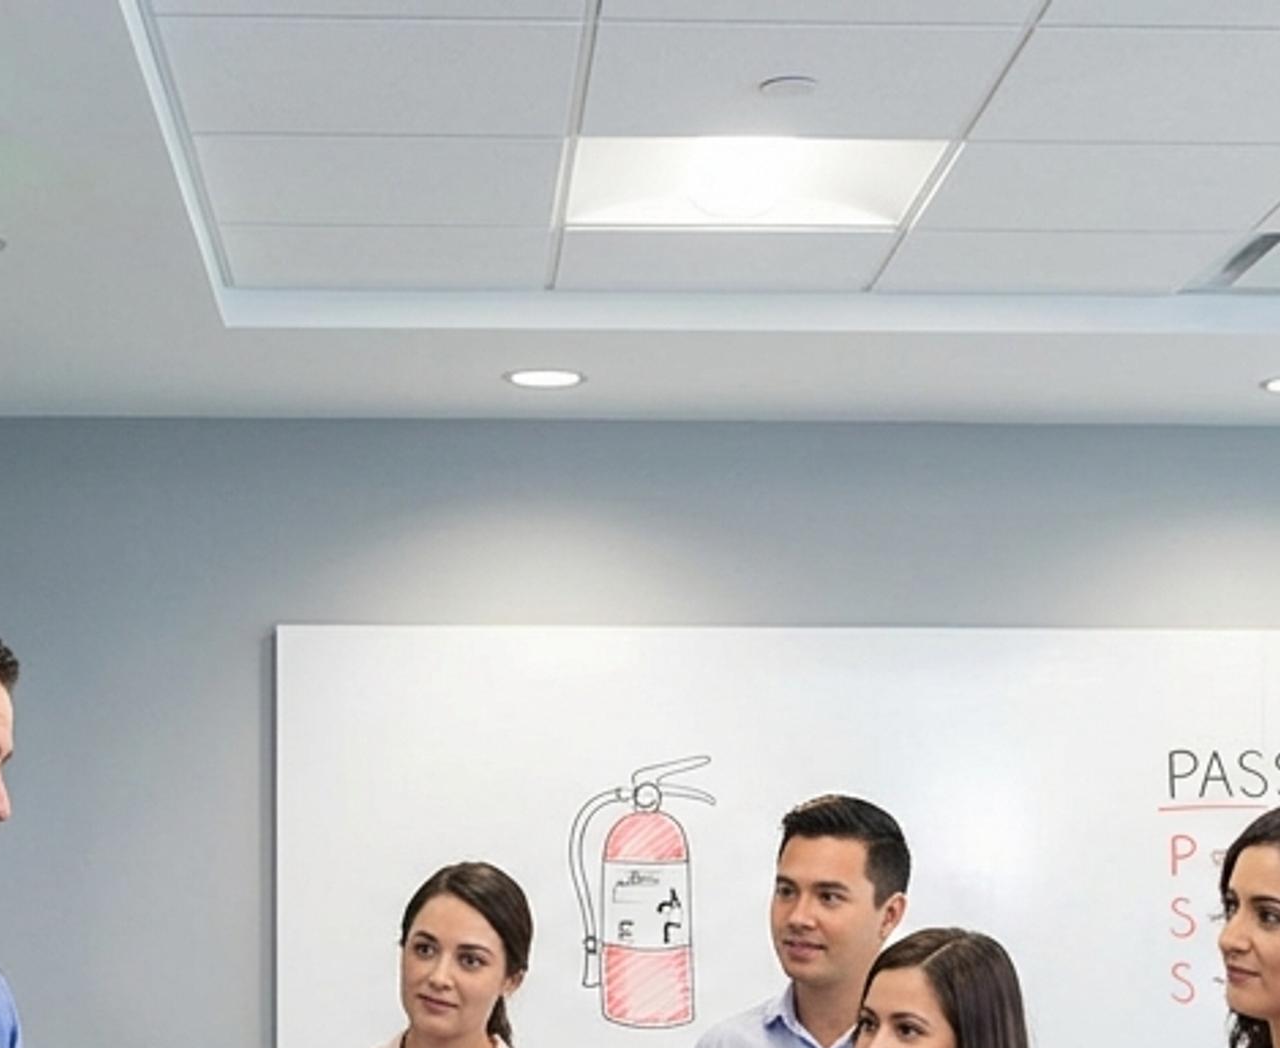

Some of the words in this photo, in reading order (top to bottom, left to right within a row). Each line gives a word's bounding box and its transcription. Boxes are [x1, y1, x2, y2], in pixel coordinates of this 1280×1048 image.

[1171, 834, 1197, 876] P
[1170, 897, 1197, 939] S
[1171, 962, 1195, 1004] S
